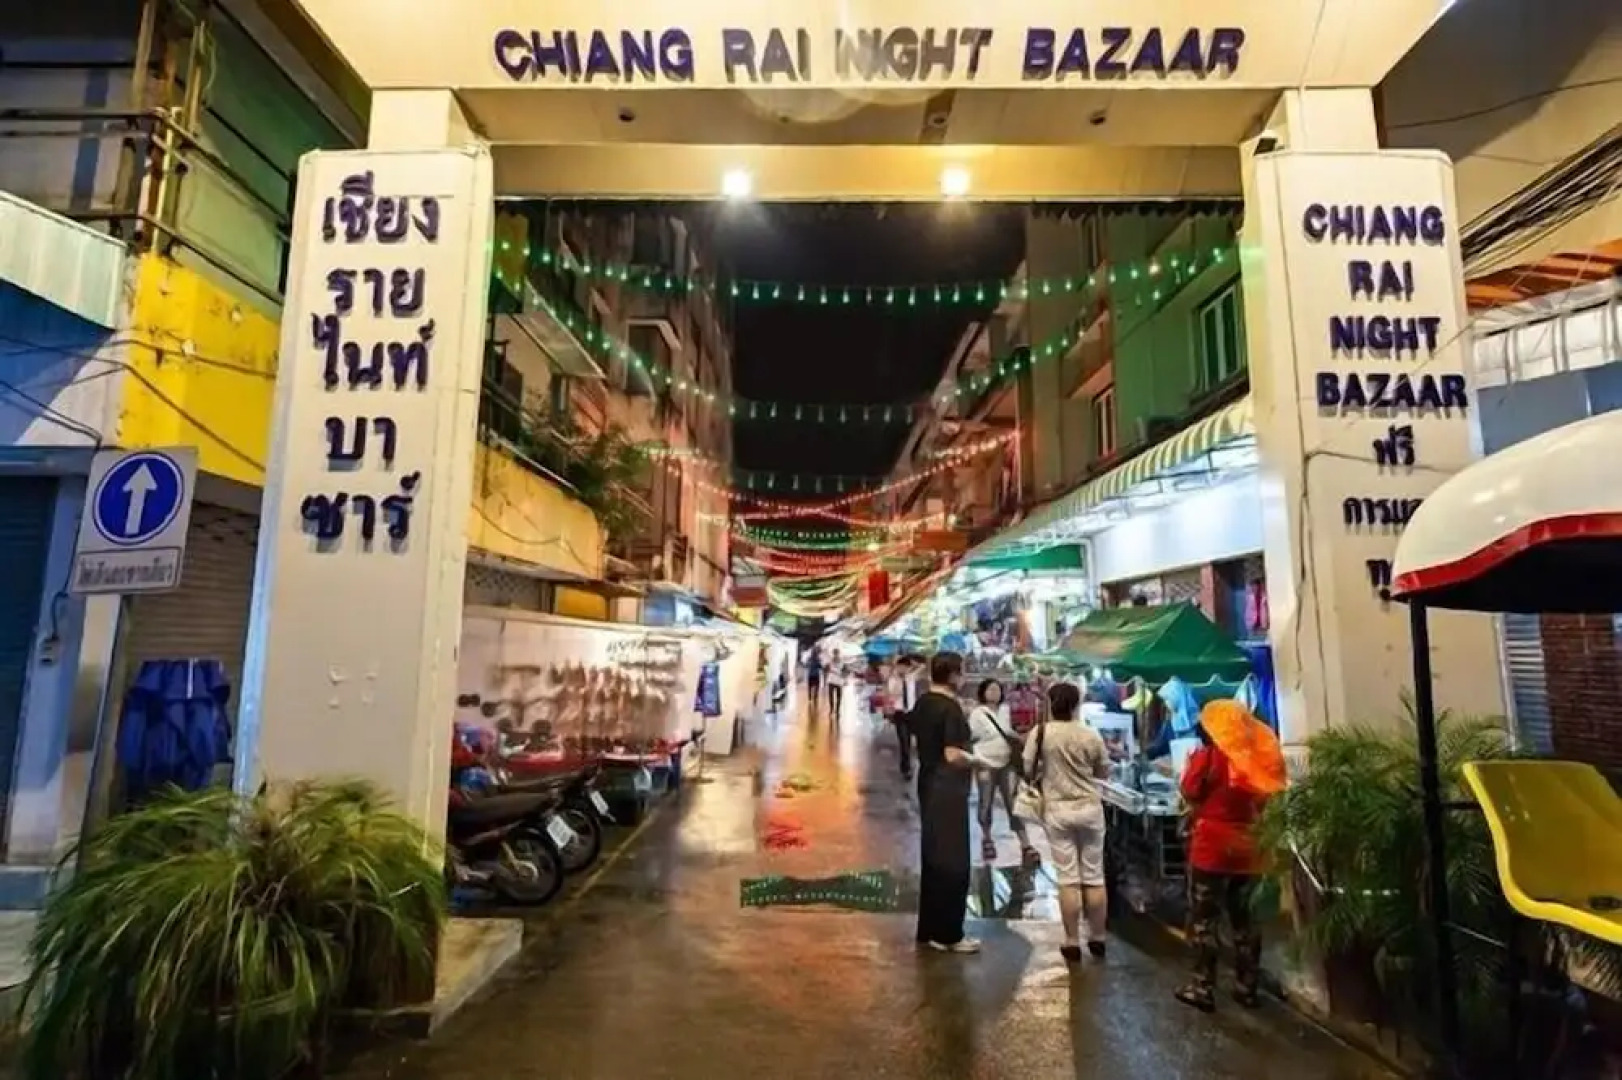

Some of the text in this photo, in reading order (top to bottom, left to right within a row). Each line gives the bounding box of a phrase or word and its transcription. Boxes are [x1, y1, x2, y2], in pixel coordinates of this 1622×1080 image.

[493, 26, 1245, 82] CHIANG RAI NIGHT BAZAAR
[322, 170, 441, 244] เชียง
[1302, 203, 1446, 246] CHIANG
[327, 267, 425, 317] ราย
[1347, 261, 1414, 301] RAI
[311, 312, 435, 391] ไนท์
[1329, 316, 1441, 359] NIGHT
[1315, 372, 1469, 415] BAZAAR
[325, 415, 397, 469] บา
[301, 471, 421, 549] ซาร์
